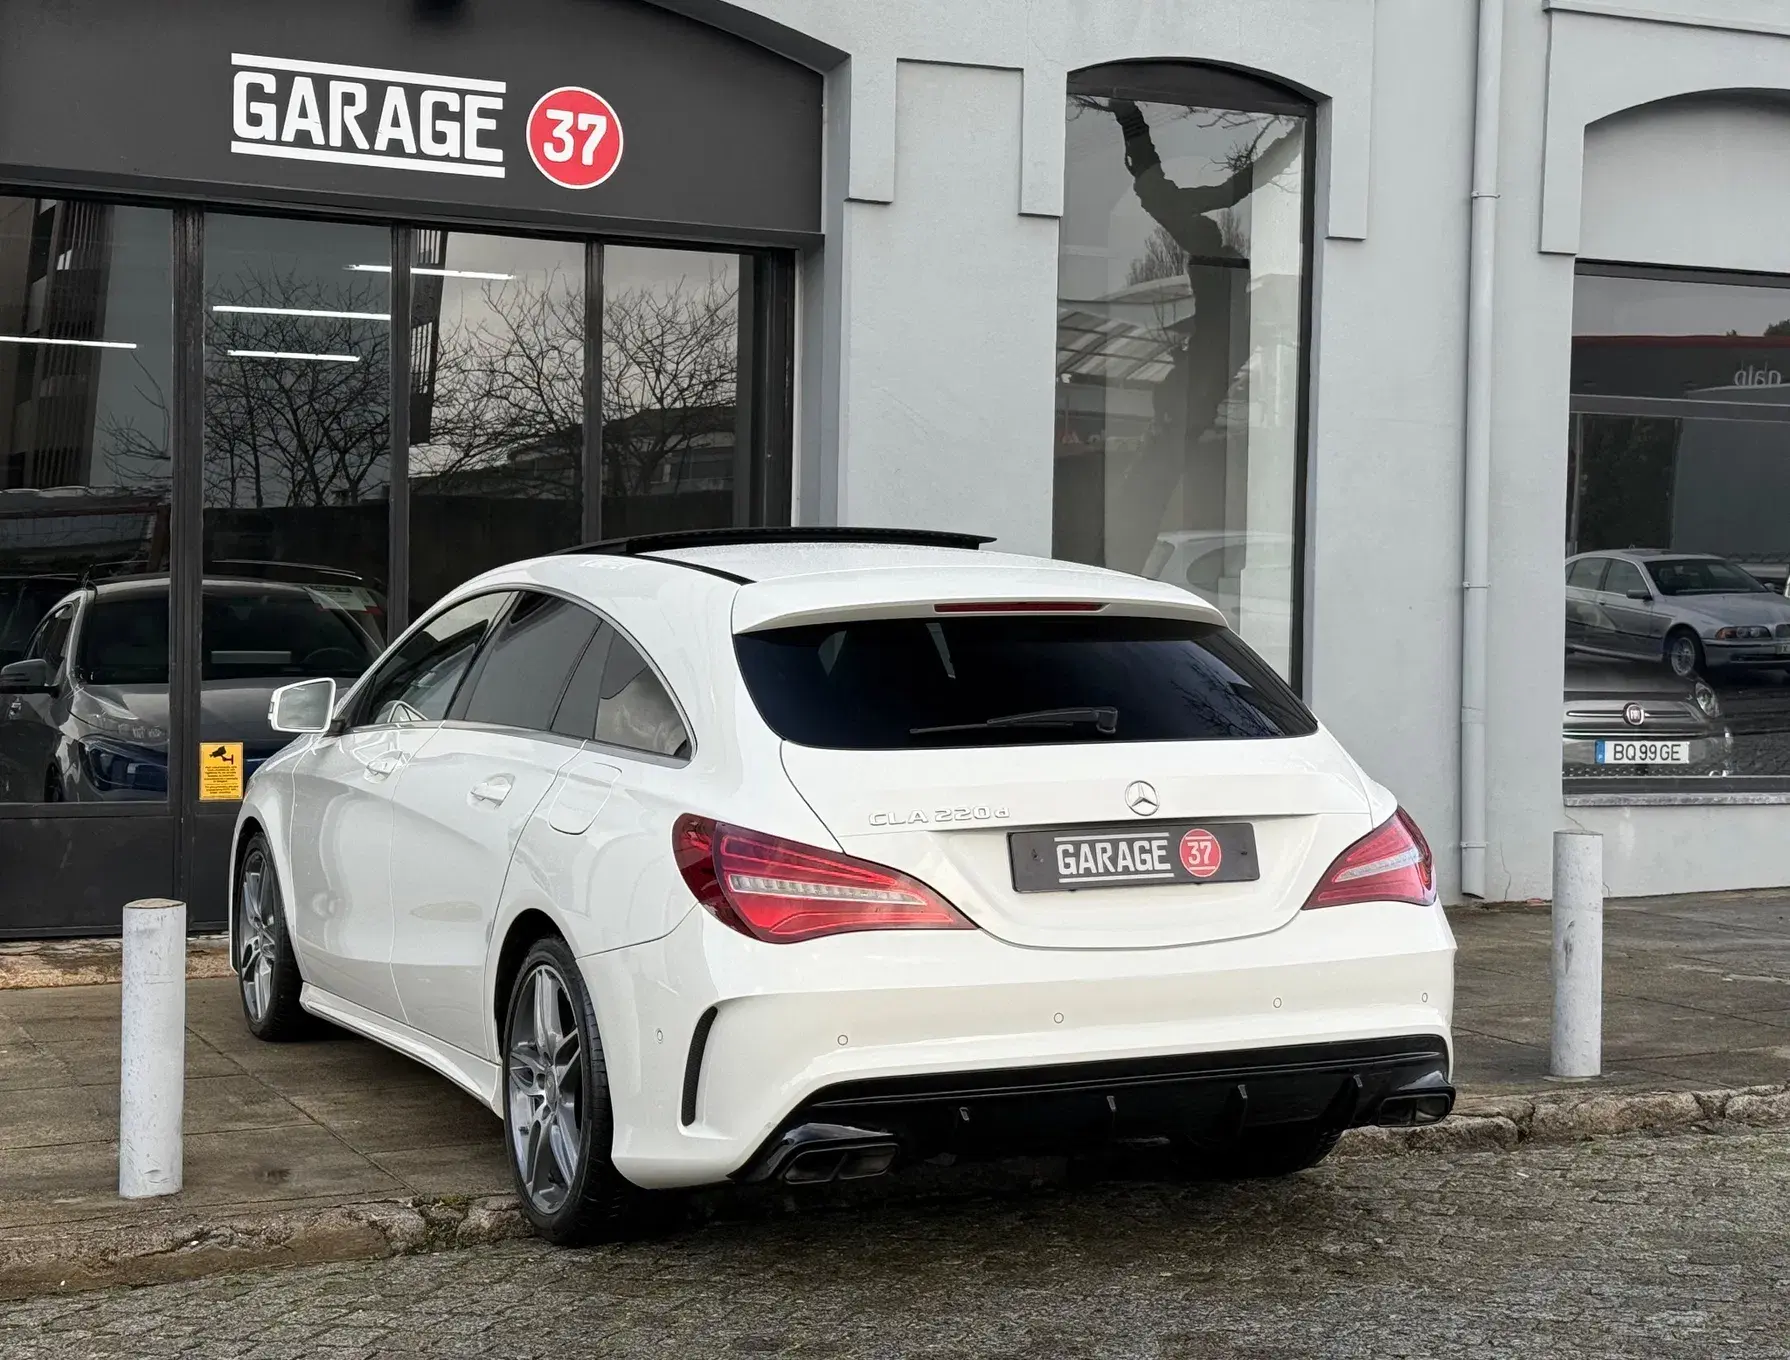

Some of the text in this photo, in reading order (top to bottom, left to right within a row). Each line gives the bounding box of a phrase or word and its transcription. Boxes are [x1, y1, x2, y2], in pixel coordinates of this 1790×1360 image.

[232, 70, 609, 167] GARAGE 37
[867, 808, 930, 827] CLA
[1055, 839, 1213, 876] GARAGE 37
